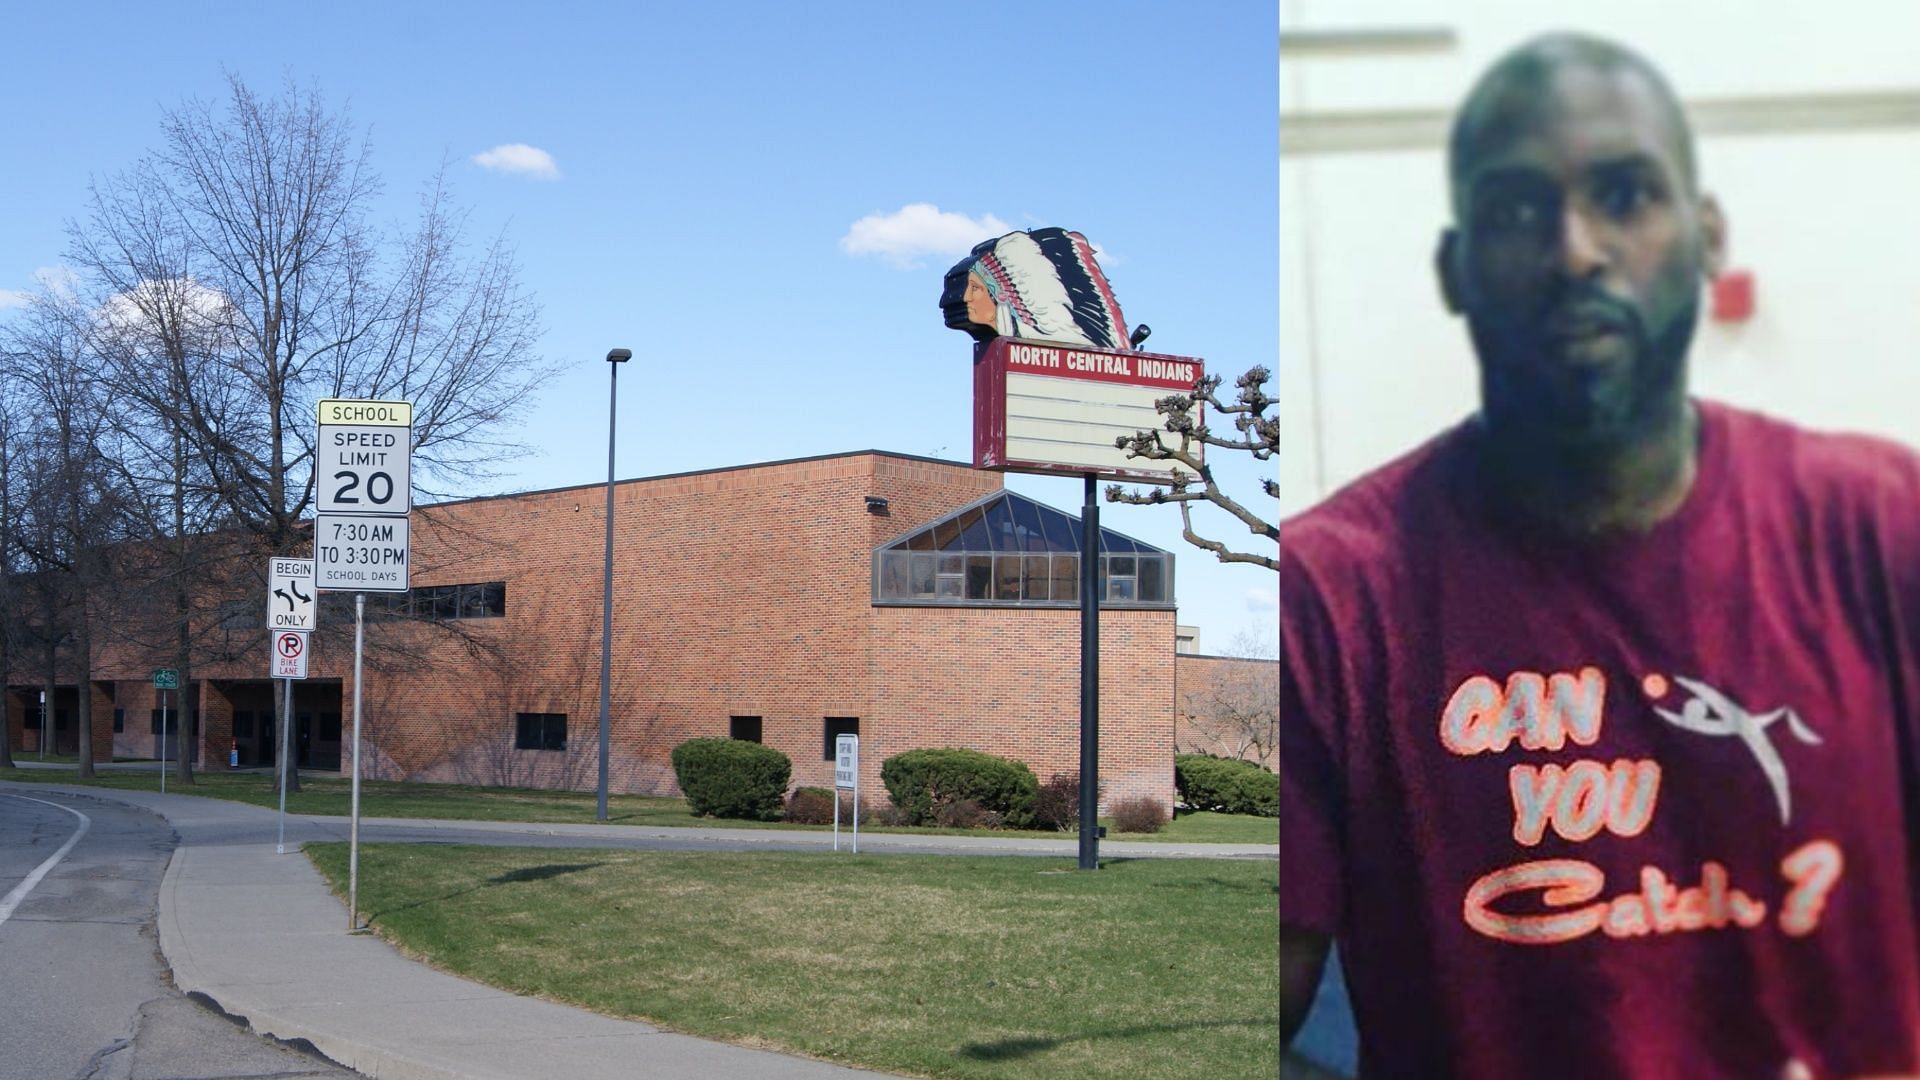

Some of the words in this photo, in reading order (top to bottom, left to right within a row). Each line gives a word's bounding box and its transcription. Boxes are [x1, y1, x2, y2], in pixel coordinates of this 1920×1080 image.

[1010, 345, 1060, 368] NORTH
[1067, 351, 1131, 376] CENTRAL
[1137, 359, 1194, 382] INDIANS
[333, 406, 398, 421] SCHOOL
[334, 432, 396, 447] SPEED
[340, 451, 388, 466] LIMIT
[333, 471, 394, 504] 20
[333, 524, 368, 541] 7:30
[371, 525, 393, 542] AM
[320, 546, 339, 563] TO
[345, 547, 380, 564] 3:30
[383, 548, 404, 565] PM
[276, 563, 311, 575] BEGIN
[327, 570, 367, 580] SCHOOL
[371, 572, 397, 581] DAYS
[276, 614, 307, 626] ONLY
[280, 658, 298, 667] BIKE
[279, 667, 298, 675] LANE
[1440, 666, 1606, 756] CAN
[1509, 758, 1662, 846] YOU
[1463, 858, 1767, 944] Catch
